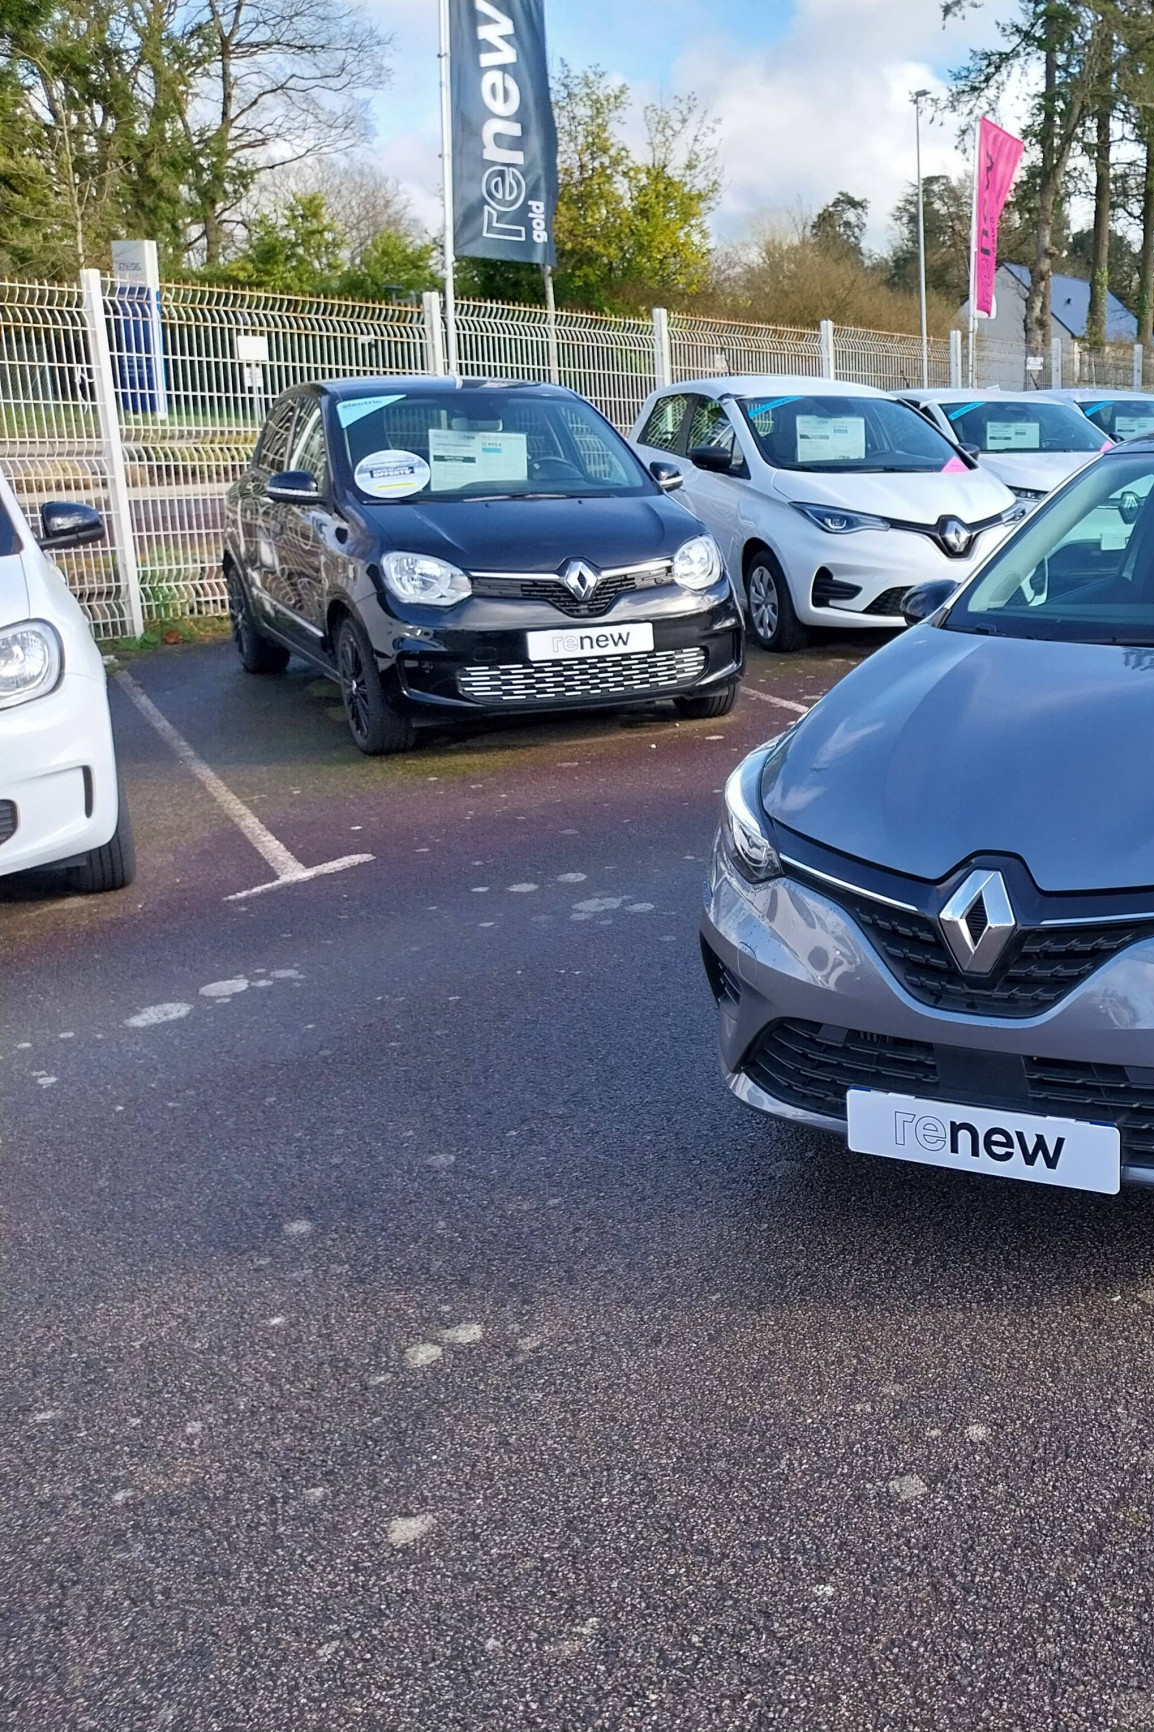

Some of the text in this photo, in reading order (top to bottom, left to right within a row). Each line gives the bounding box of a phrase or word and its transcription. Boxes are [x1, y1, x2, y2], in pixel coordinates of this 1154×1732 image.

[474, 0, 526, 241] renew
[528, 200, 548, 243] gold
[552, 631, 630, 653] renew
[893, 1110, 1066, 1171] renew
